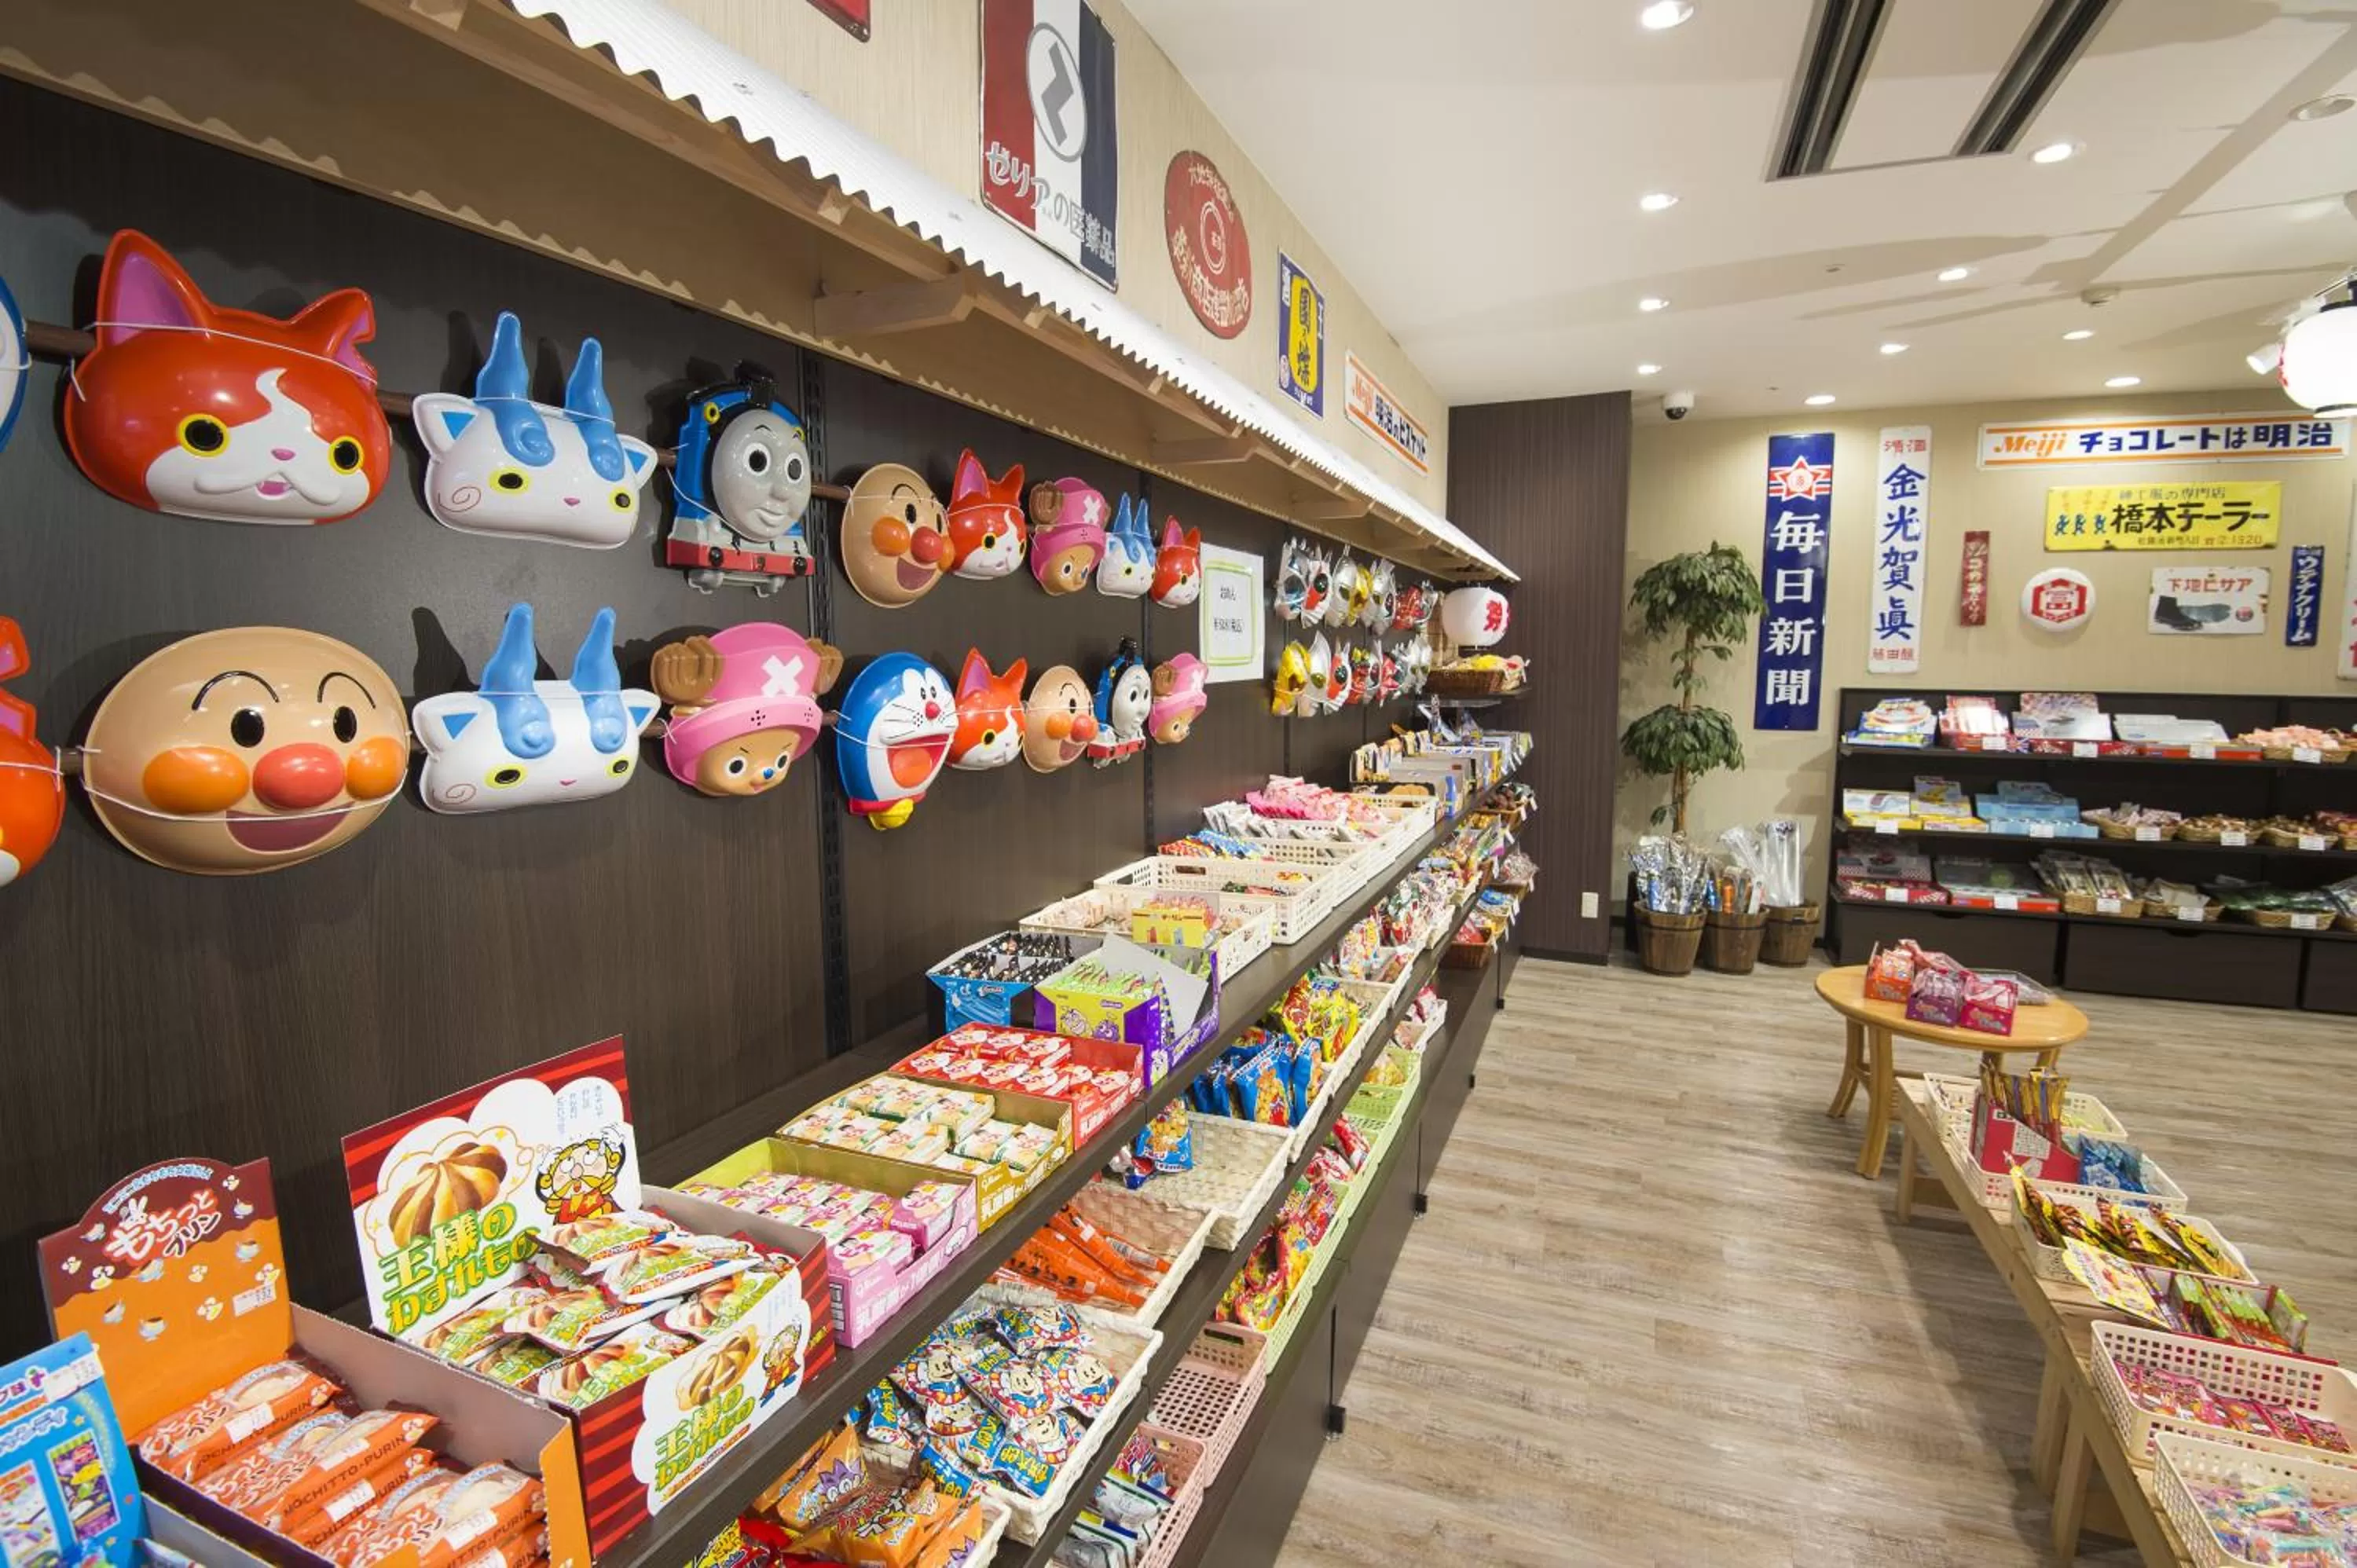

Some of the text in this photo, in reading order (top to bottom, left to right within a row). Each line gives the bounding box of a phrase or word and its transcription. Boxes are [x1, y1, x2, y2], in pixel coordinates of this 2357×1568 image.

[1993, 423, 2333, 457] Meiji チョコレートは明治
[2110, 501, 2271, 534] 橋本テーラー
[1765, 511, 1825, 705] 毎日新聞
[104, 1189, 215, 1260] もちっと
[163, 1212, 221, 1257] プリン
